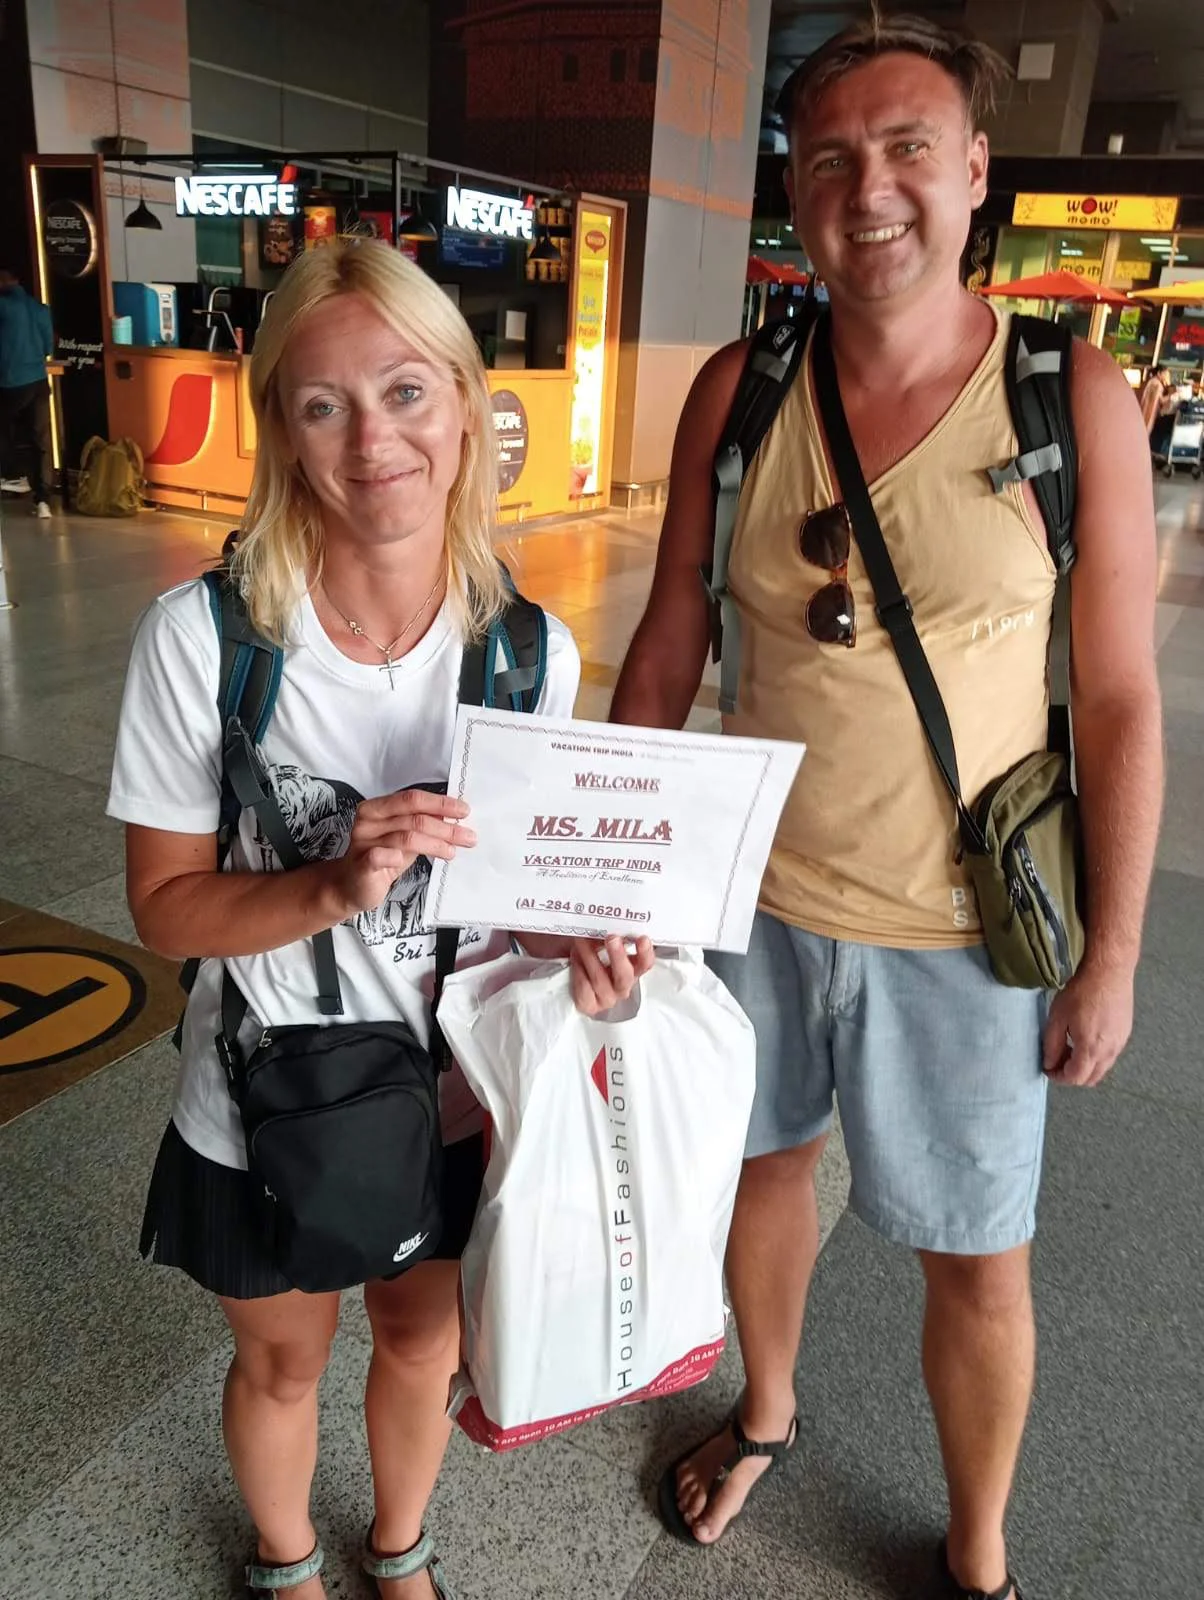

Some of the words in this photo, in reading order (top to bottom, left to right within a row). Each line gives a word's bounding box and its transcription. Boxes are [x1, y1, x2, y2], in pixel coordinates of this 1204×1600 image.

[551, 742, 591, 753] VACATION
[593, 747, 610, 755] TRIP
[611, 749, 634, 757] INDIA
[574, 771, 662, 793] WELCOME
[526, 815, 584, 838] MS.
[591, 817, 673, 842] MILA
[523, 855, 593, 867] VACATION
[595, 858, 624, 868] TRIP
[627, 860, 662, 872] INDIA
[574, 902, 585, 914] @
[588, 904, 622, 918] 0620
[625, 909, 651, 923] hrs)
[393, 941, 423, 963] Sri
[398, 1232, 421, 1254] NIKE
